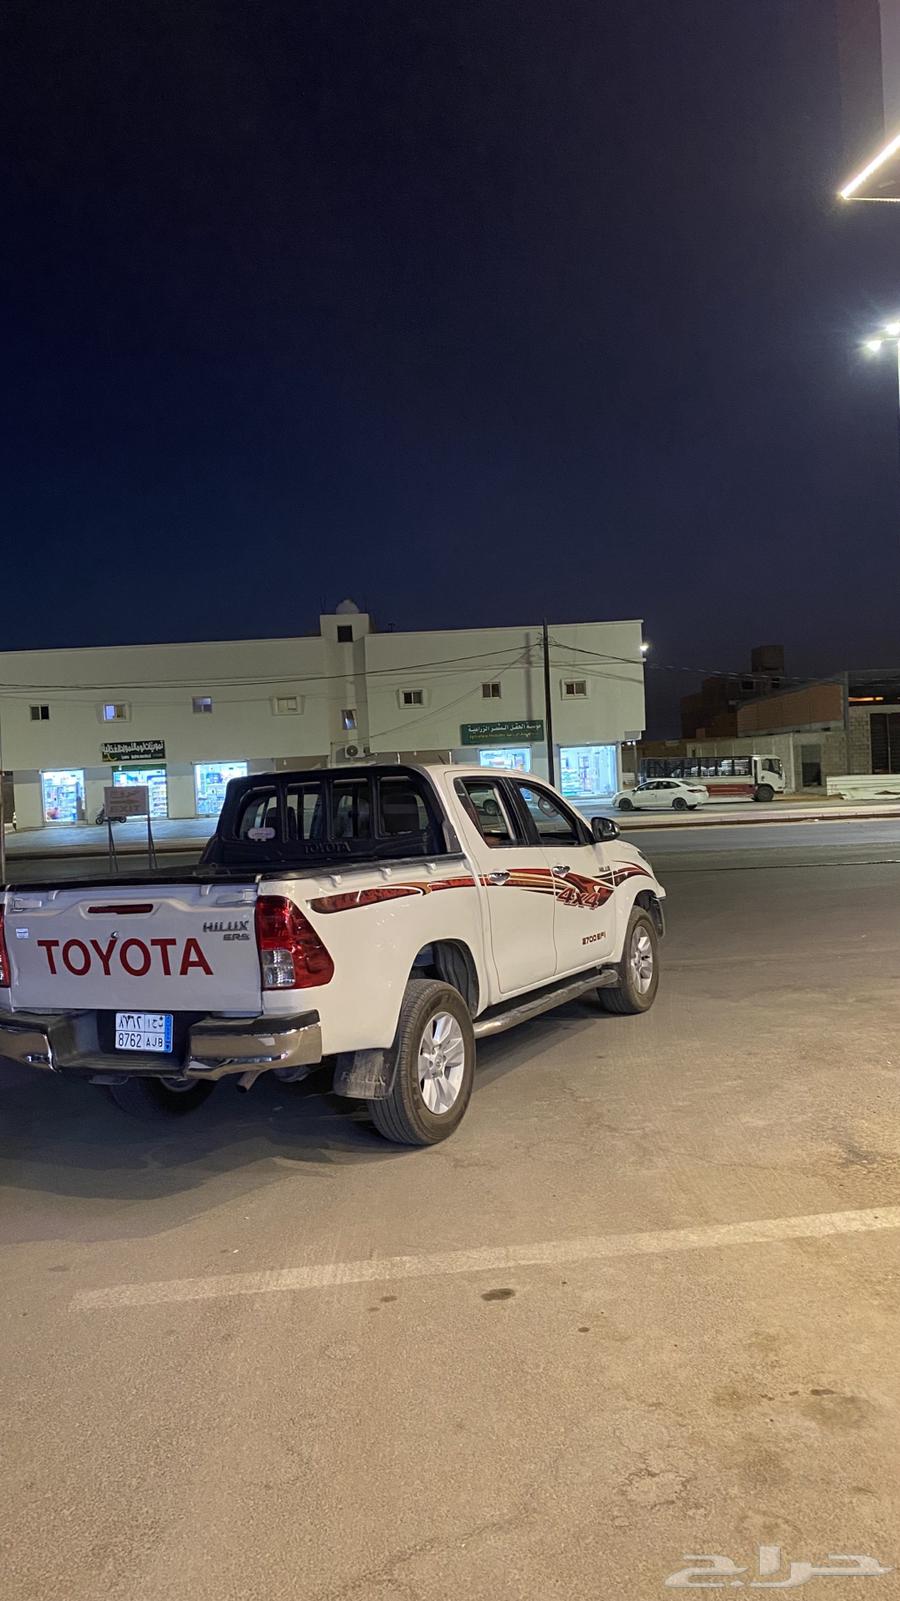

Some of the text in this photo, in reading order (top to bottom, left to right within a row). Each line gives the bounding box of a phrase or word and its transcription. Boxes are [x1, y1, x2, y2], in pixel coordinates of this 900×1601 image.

[202, 920, 250, 932] HILUX
[37, 938, 214, 977] TOYOTA
[118, 1032, 163, 1048] 8762 AJB
